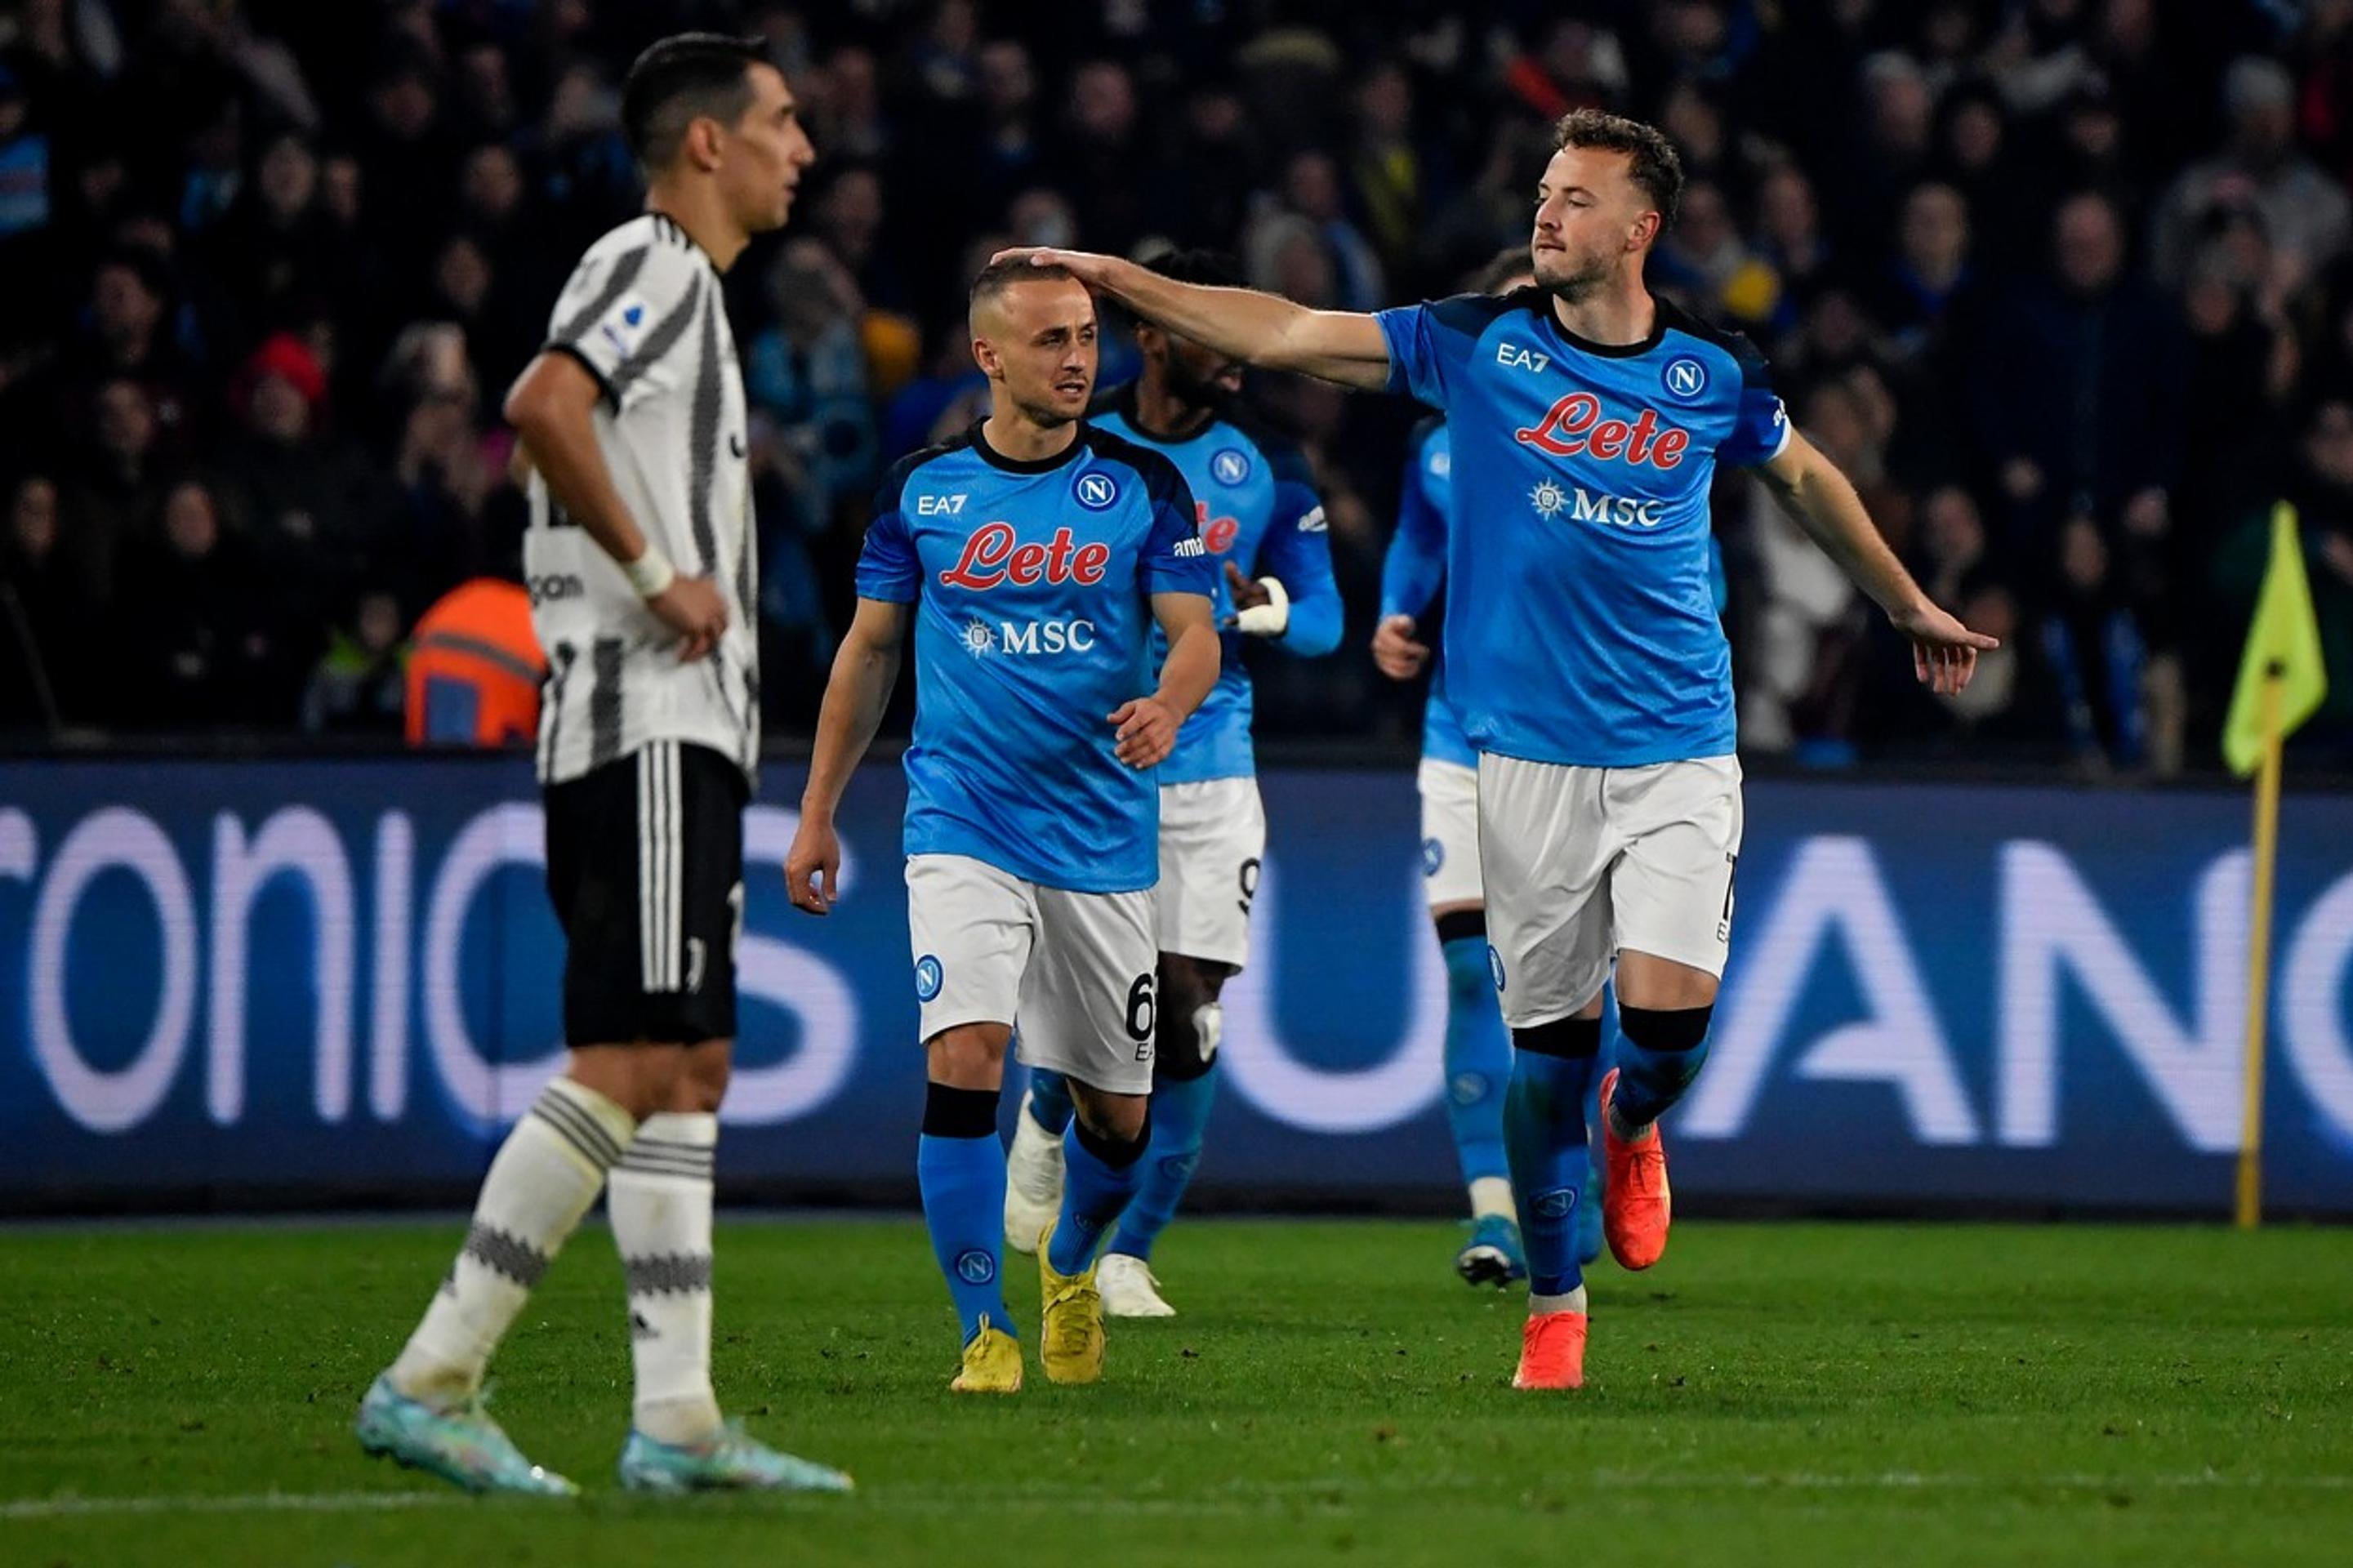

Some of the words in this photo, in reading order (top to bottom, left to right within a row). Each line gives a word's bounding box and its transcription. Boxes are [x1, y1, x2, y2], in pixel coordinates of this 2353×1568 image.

[1496, 343, 1550, 373] EA7
[1516, 391, 1689, 470] Lete
[918, 494, 967, 515] EA7
[1571, 488, 1664, 527] MSC
[938, 521, 1110, 591] Lete
[1000, 620, 1094, 654] MSC
[1126, 973, 1153, 1041] 6
